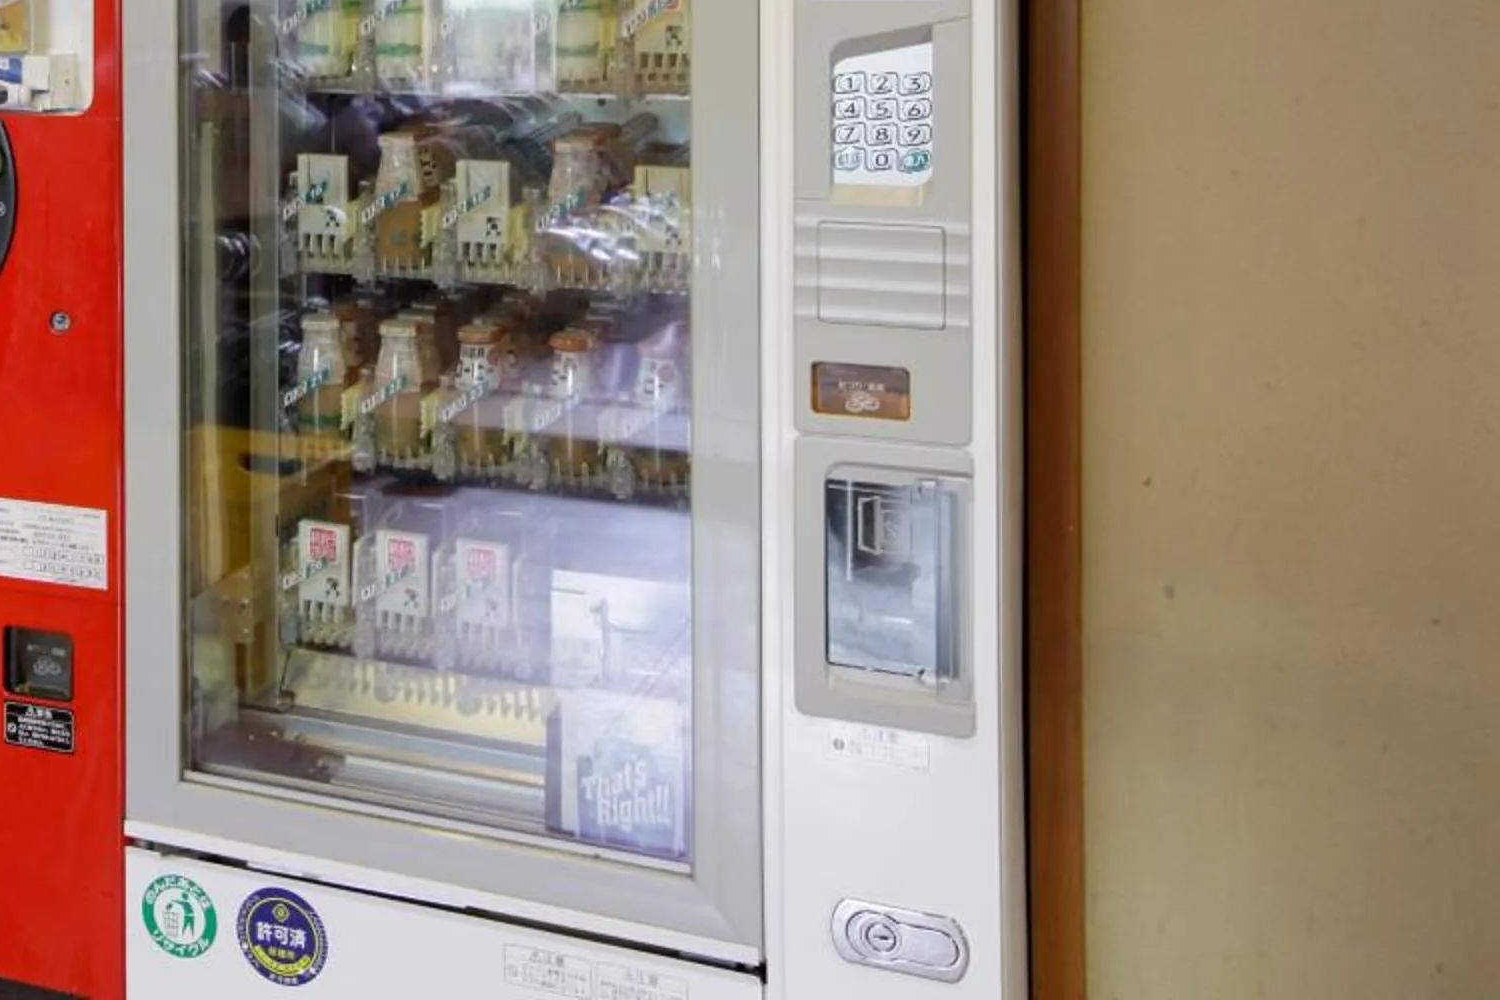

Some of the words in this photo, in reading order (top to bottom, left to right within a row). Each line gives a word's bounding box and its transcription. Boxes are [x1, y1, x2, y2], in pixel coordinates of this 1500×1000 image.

[847, 77, 853, 91] 1
[877, 76, 888, 90] 2
[911, 77, 921, 90] 3
[844, 103, 855, 115] 4
[876, 103, 888, 117] 5
[908, 104, 921, 117] 6
[844, 127, 855, 141] 7
[876, 128, 888, 141] 8
[907, 129, 921, 142] 9
[875, 153, 888, 166] 0
[581, 760, 648, 800] That's
[256, 921, 306, 949] 許可済
[152, 929, 210, 957] リサイクル
